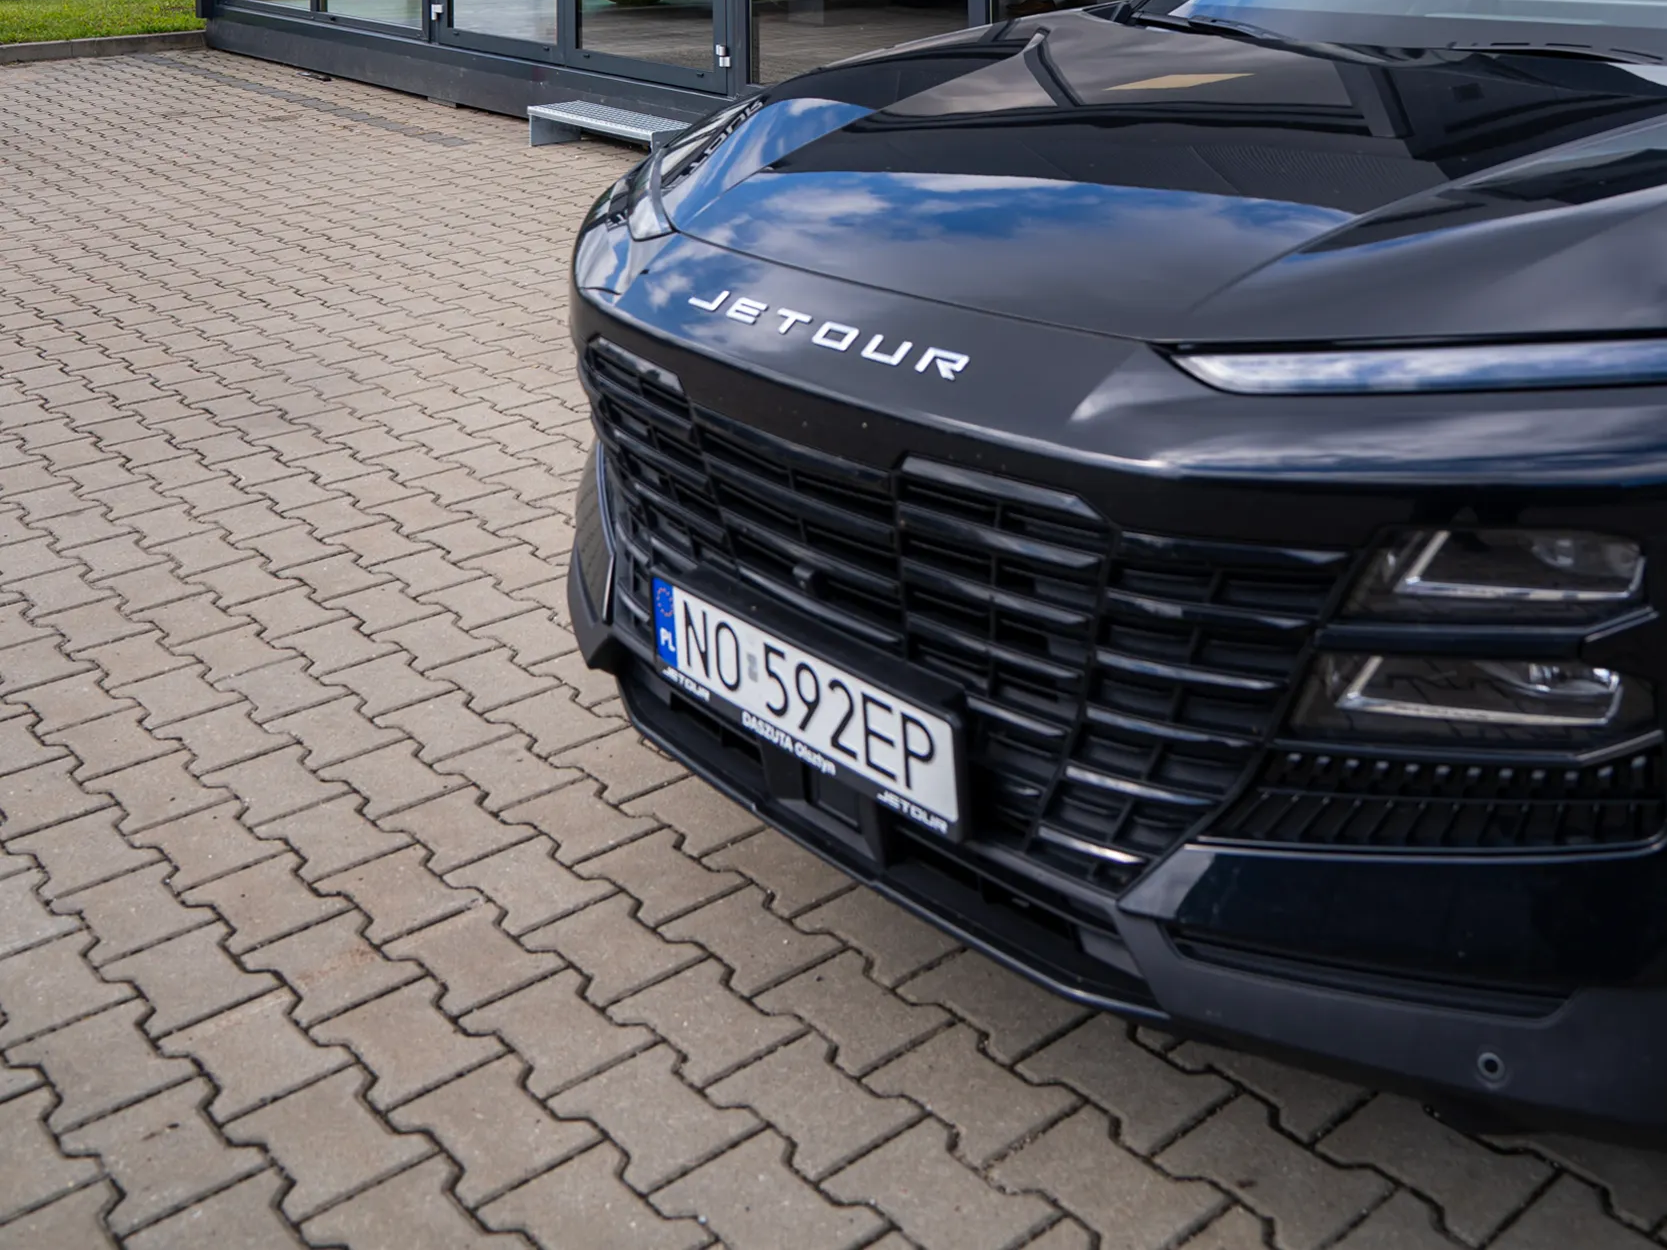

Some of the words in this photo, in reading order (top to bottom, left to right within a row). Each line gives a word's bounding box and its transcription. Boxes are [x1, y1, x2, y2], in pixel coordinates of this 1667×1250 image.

[688, 290, 970, 380] JETOUR
[660, 627, 676, 652] PL
[662, 666, 711, 702] JETOUR
[683, 600, 741, 692] NO
[763, 642, 936, 791] 592EP
[741, 710, 795, 753] DASZUTA
[876, 790, 949, 834] JETOUR
